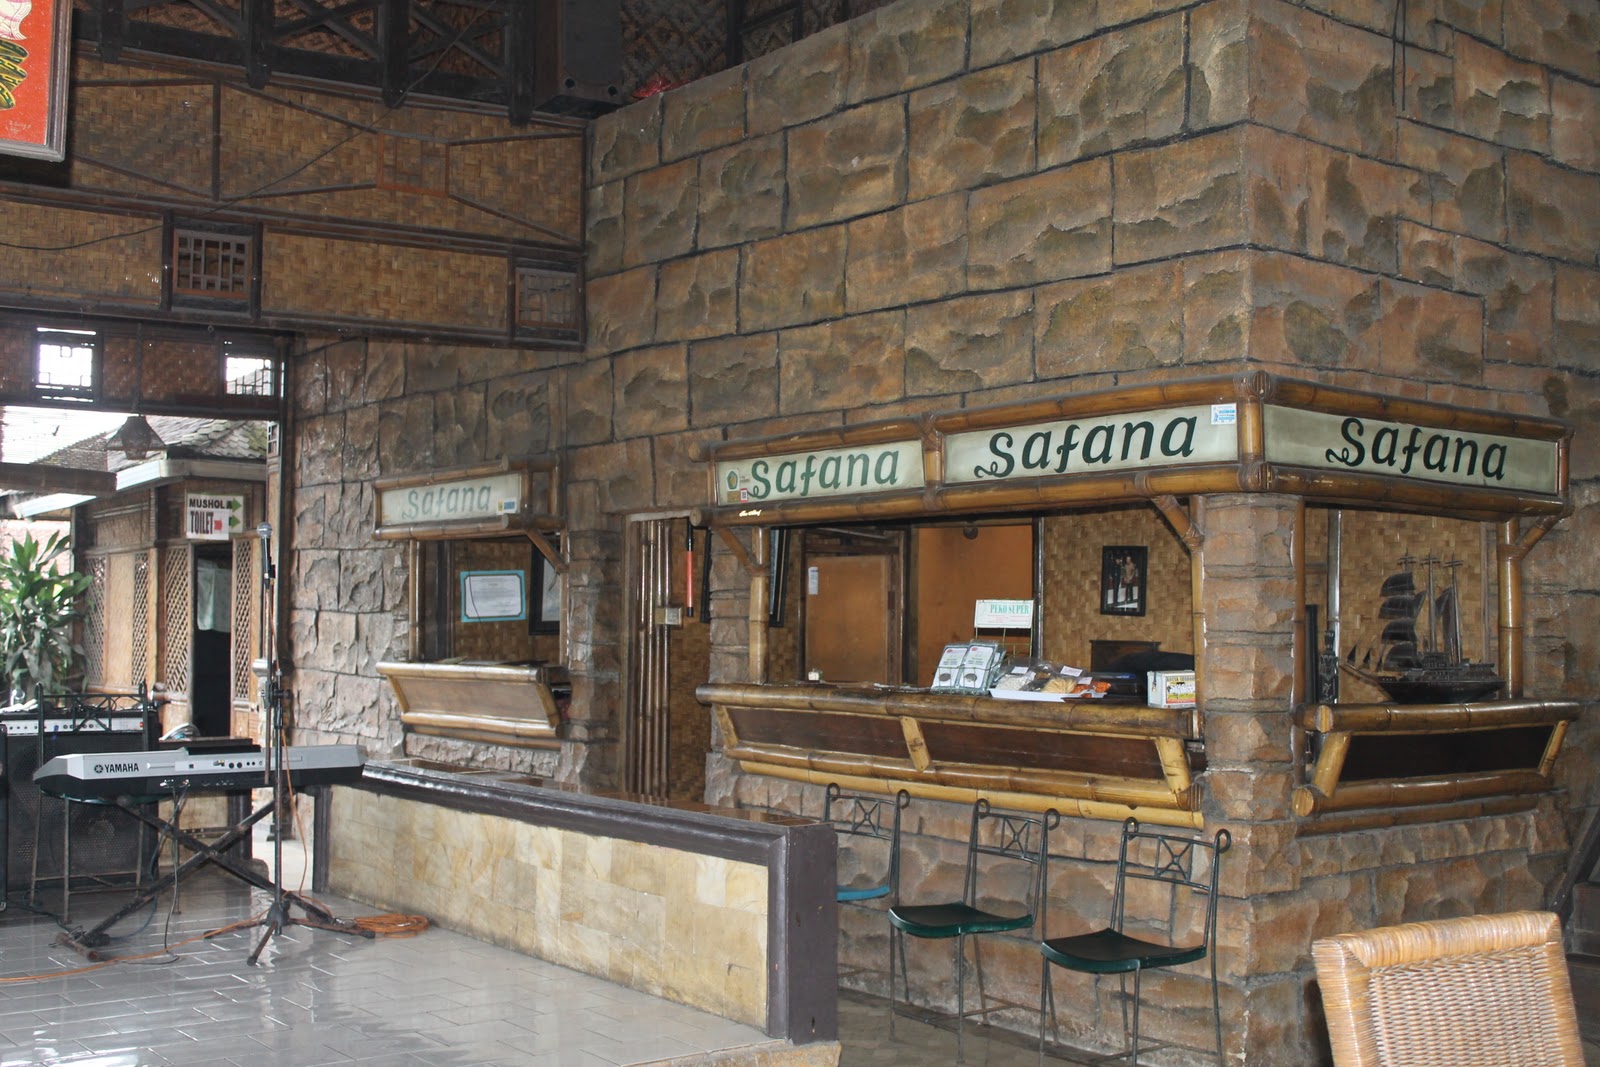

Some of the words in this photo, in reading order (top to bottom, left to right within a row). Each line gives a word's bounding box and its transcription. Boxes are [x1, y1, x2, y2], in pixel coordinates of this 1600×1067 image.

[974, 416, 1198, 478] Safana
[1325, 417, 1508, 480] Safana
[748, 450, 899, 500] Safana
[190, 511, 214, 534] TOILET
[401, 485, 491, 520] Safana
[105, 763, 139, 773] YAMAHA
